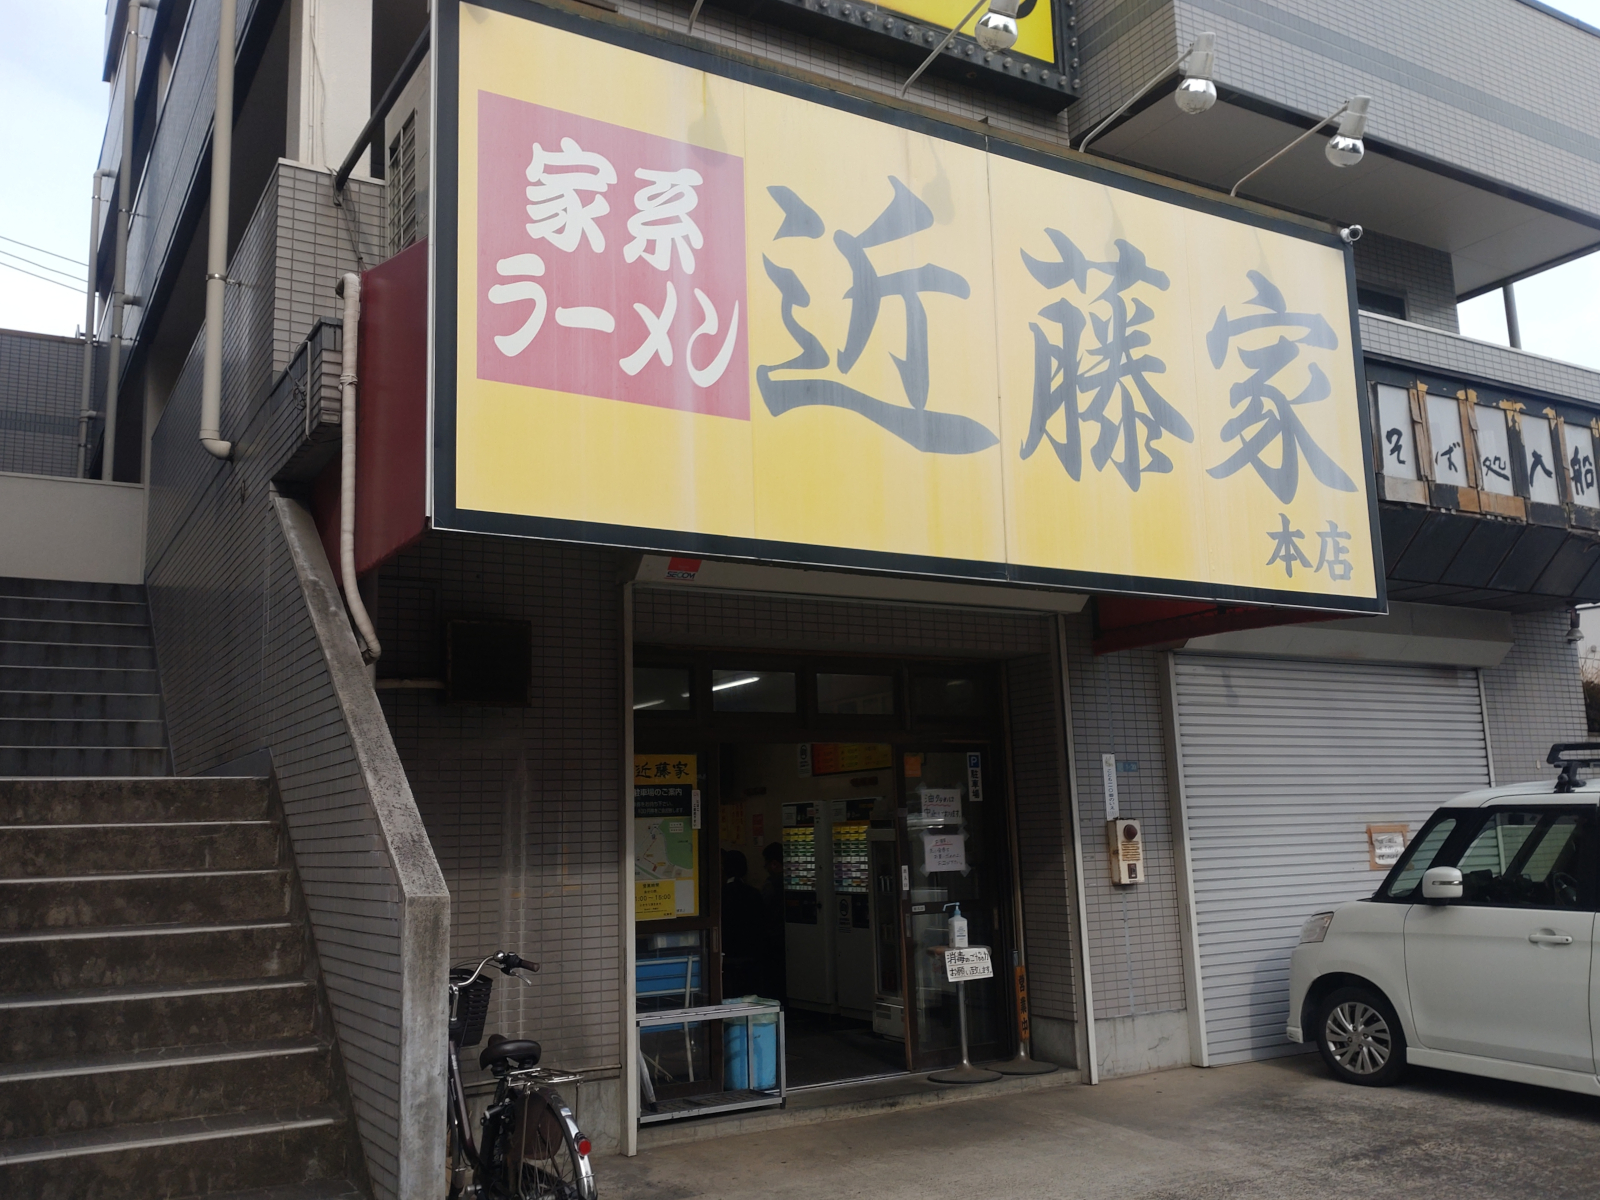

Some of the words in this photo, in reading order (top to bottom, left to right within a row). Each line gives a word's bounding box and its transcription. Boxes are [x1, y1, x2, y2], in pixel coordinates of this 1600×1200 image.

[525, 136, 704, 275] 家系
[487, 253, 739, 388] ラーメン
[756, 175, 1359, 506] 近藤家
[666, 570, 696, 580] SECOM
[1265, 512, 1353, 582] 本店
[634, 761, 689, 779] 近藤家
[971, 769, 980, 799] 駐車場
